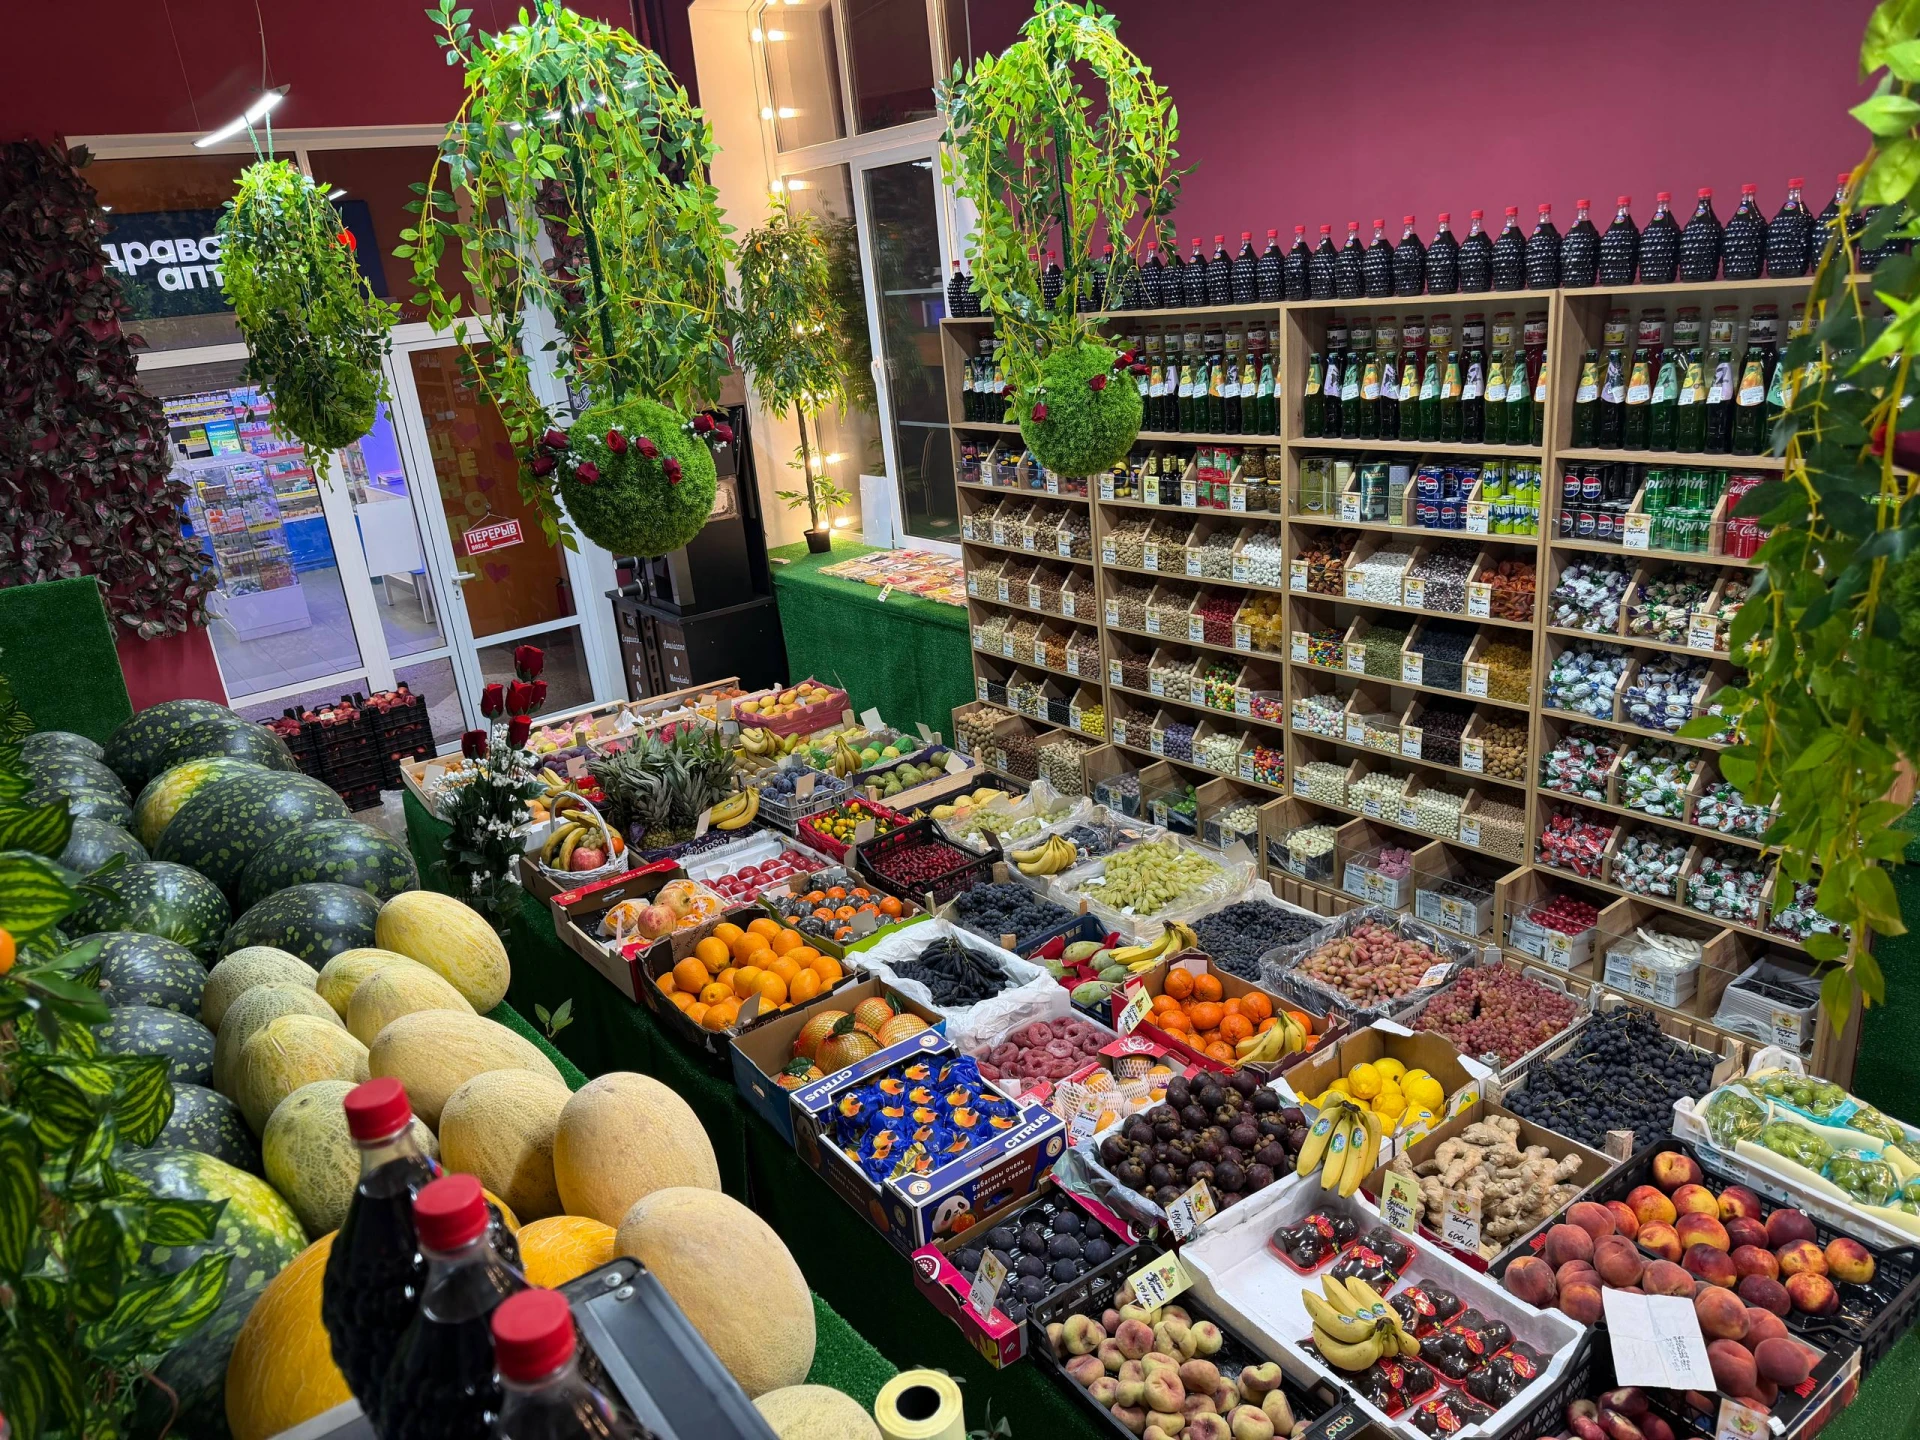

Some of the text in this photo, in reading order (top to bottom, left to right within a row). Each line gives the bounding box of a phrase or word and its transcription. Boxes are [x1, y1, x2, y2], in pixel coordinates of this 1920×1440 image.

[468, 523, 517, 544] ПЕРЕРЫВ
[471, 541, 489, 551] BREAK
[804, 1070, 853, 1102] CITRUS
[1004, 1113, 1051, 1149] CITRUS
[971, 1159, 1025, 1192] Бабаганы очень
[973, 1182, 1000, 1201] сладкие
[1008, 1164, 1032, 1181] свежие
